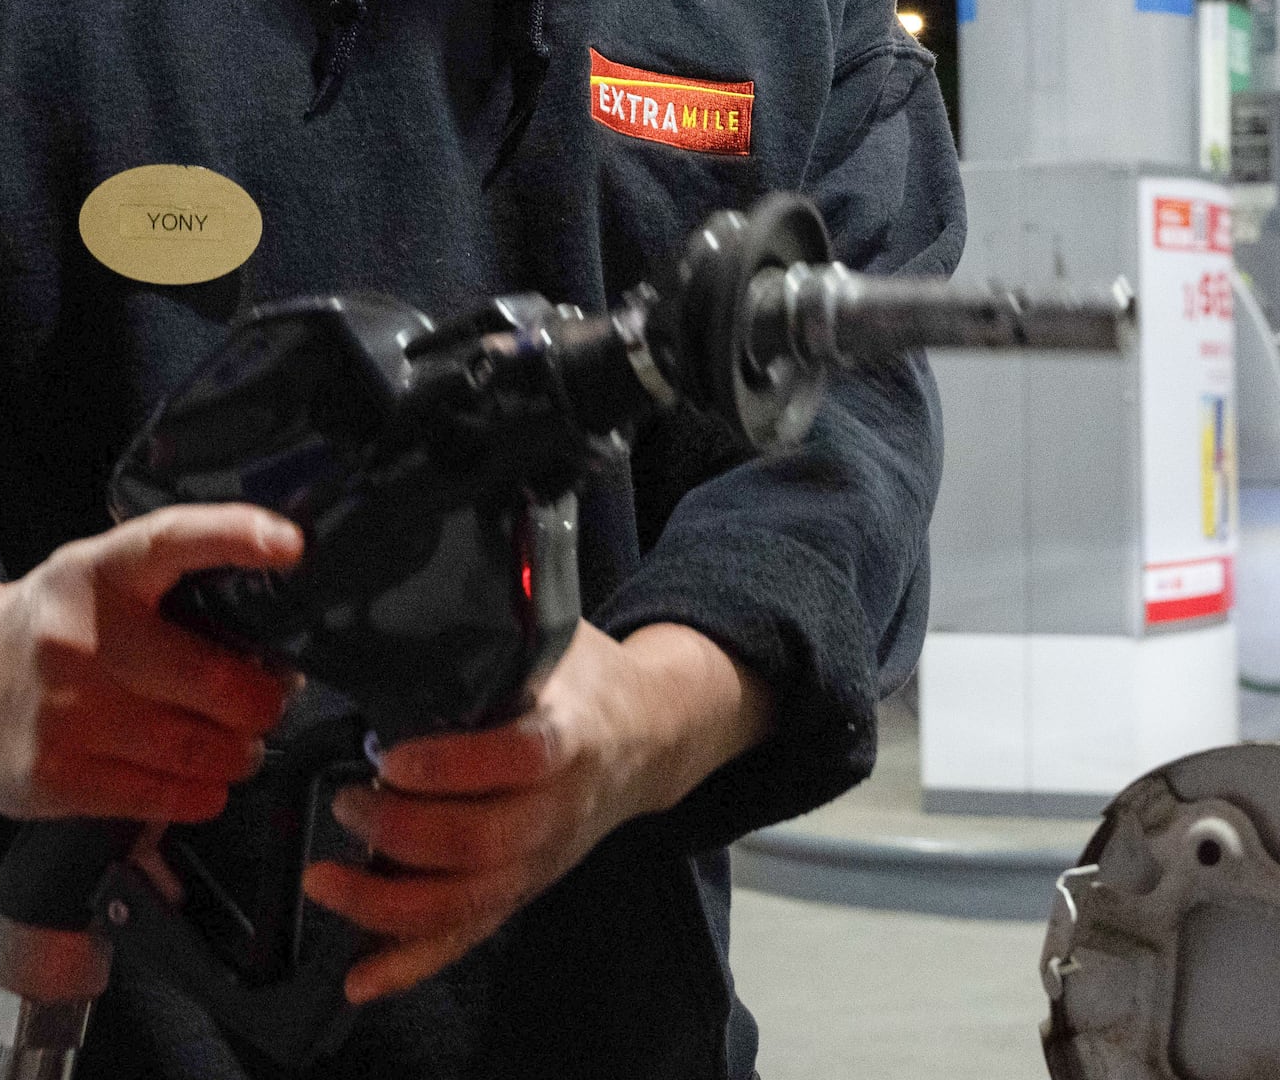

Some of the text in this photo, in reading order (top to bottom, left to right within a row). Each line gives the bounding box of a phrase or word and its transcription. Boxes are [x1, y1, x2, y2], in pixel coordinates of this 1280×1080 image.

[599, 83, 740, 134] EXTRA MILE
[147, 212, 208, 232] YONY
